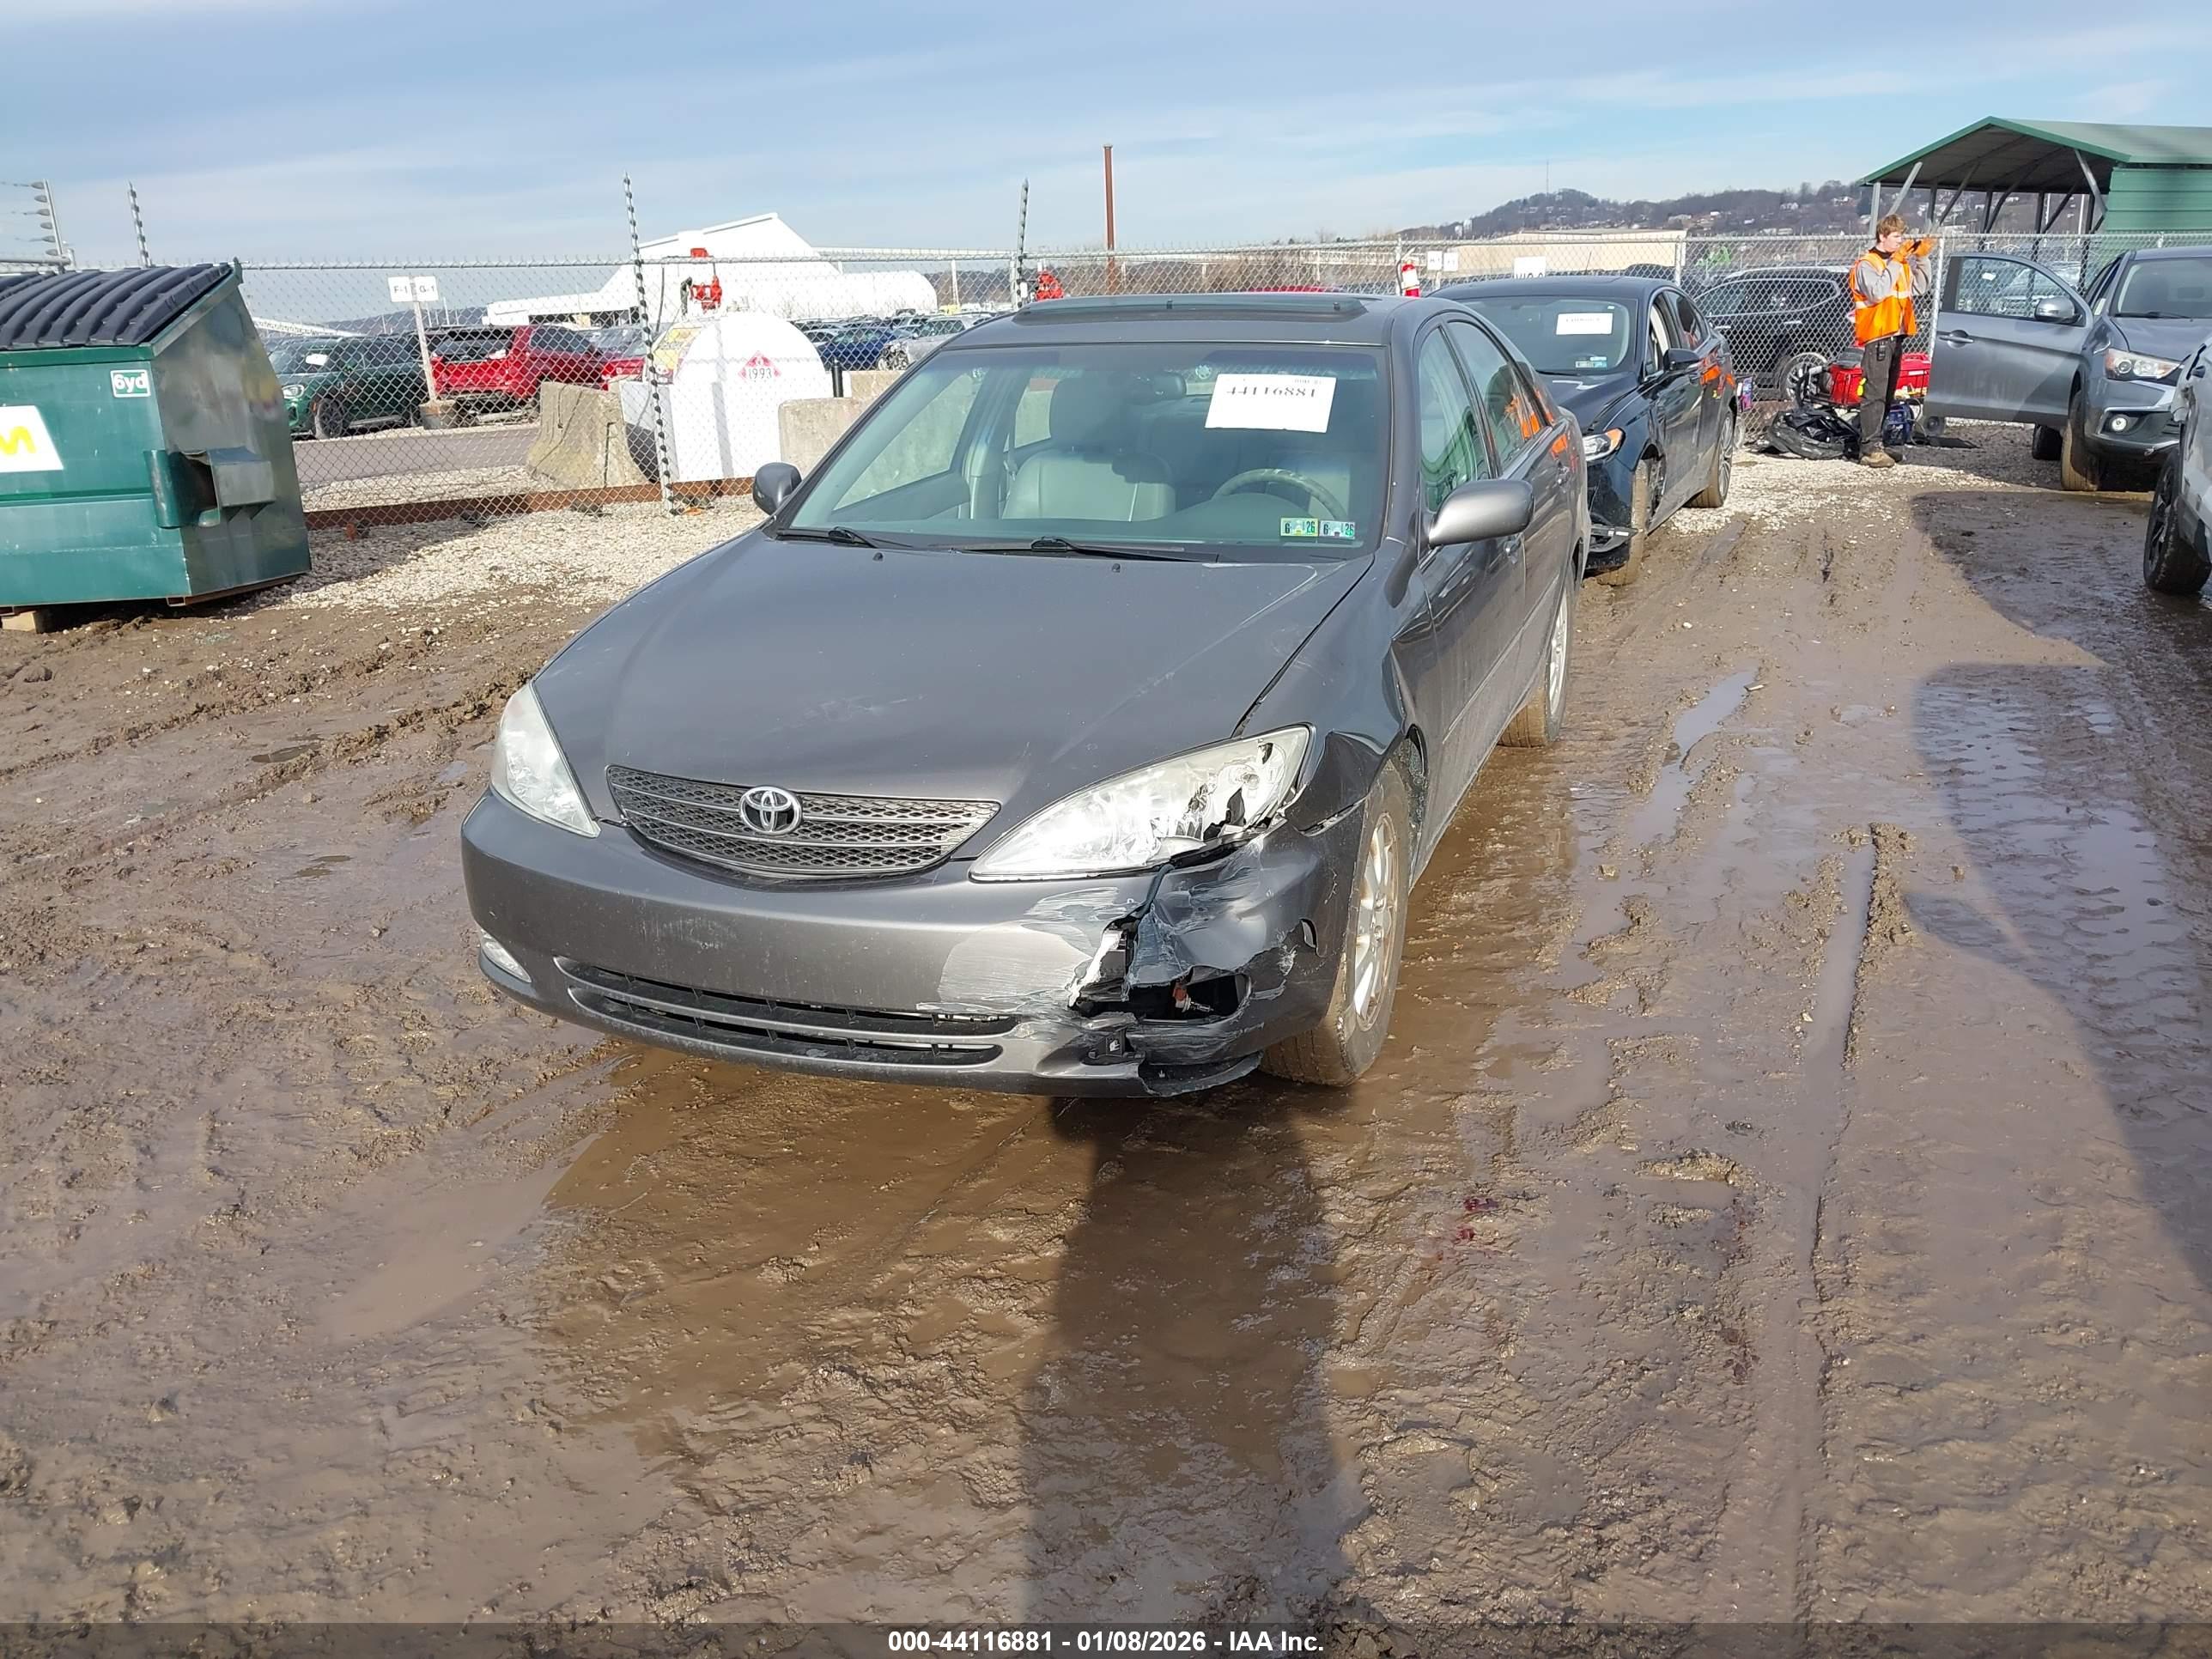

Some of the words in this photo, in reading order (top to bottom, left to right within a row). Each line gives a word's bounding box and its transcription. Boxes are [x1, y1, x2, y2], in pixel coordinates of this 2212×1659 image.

[748, 368, 772, 380] 1993
[113, 373, 147, 393] 6yd
[1226, 386, 1316, 398] 44116881
[1285, 522, 1291, 534] 6
[1306, 520, 1316, 533] 26
